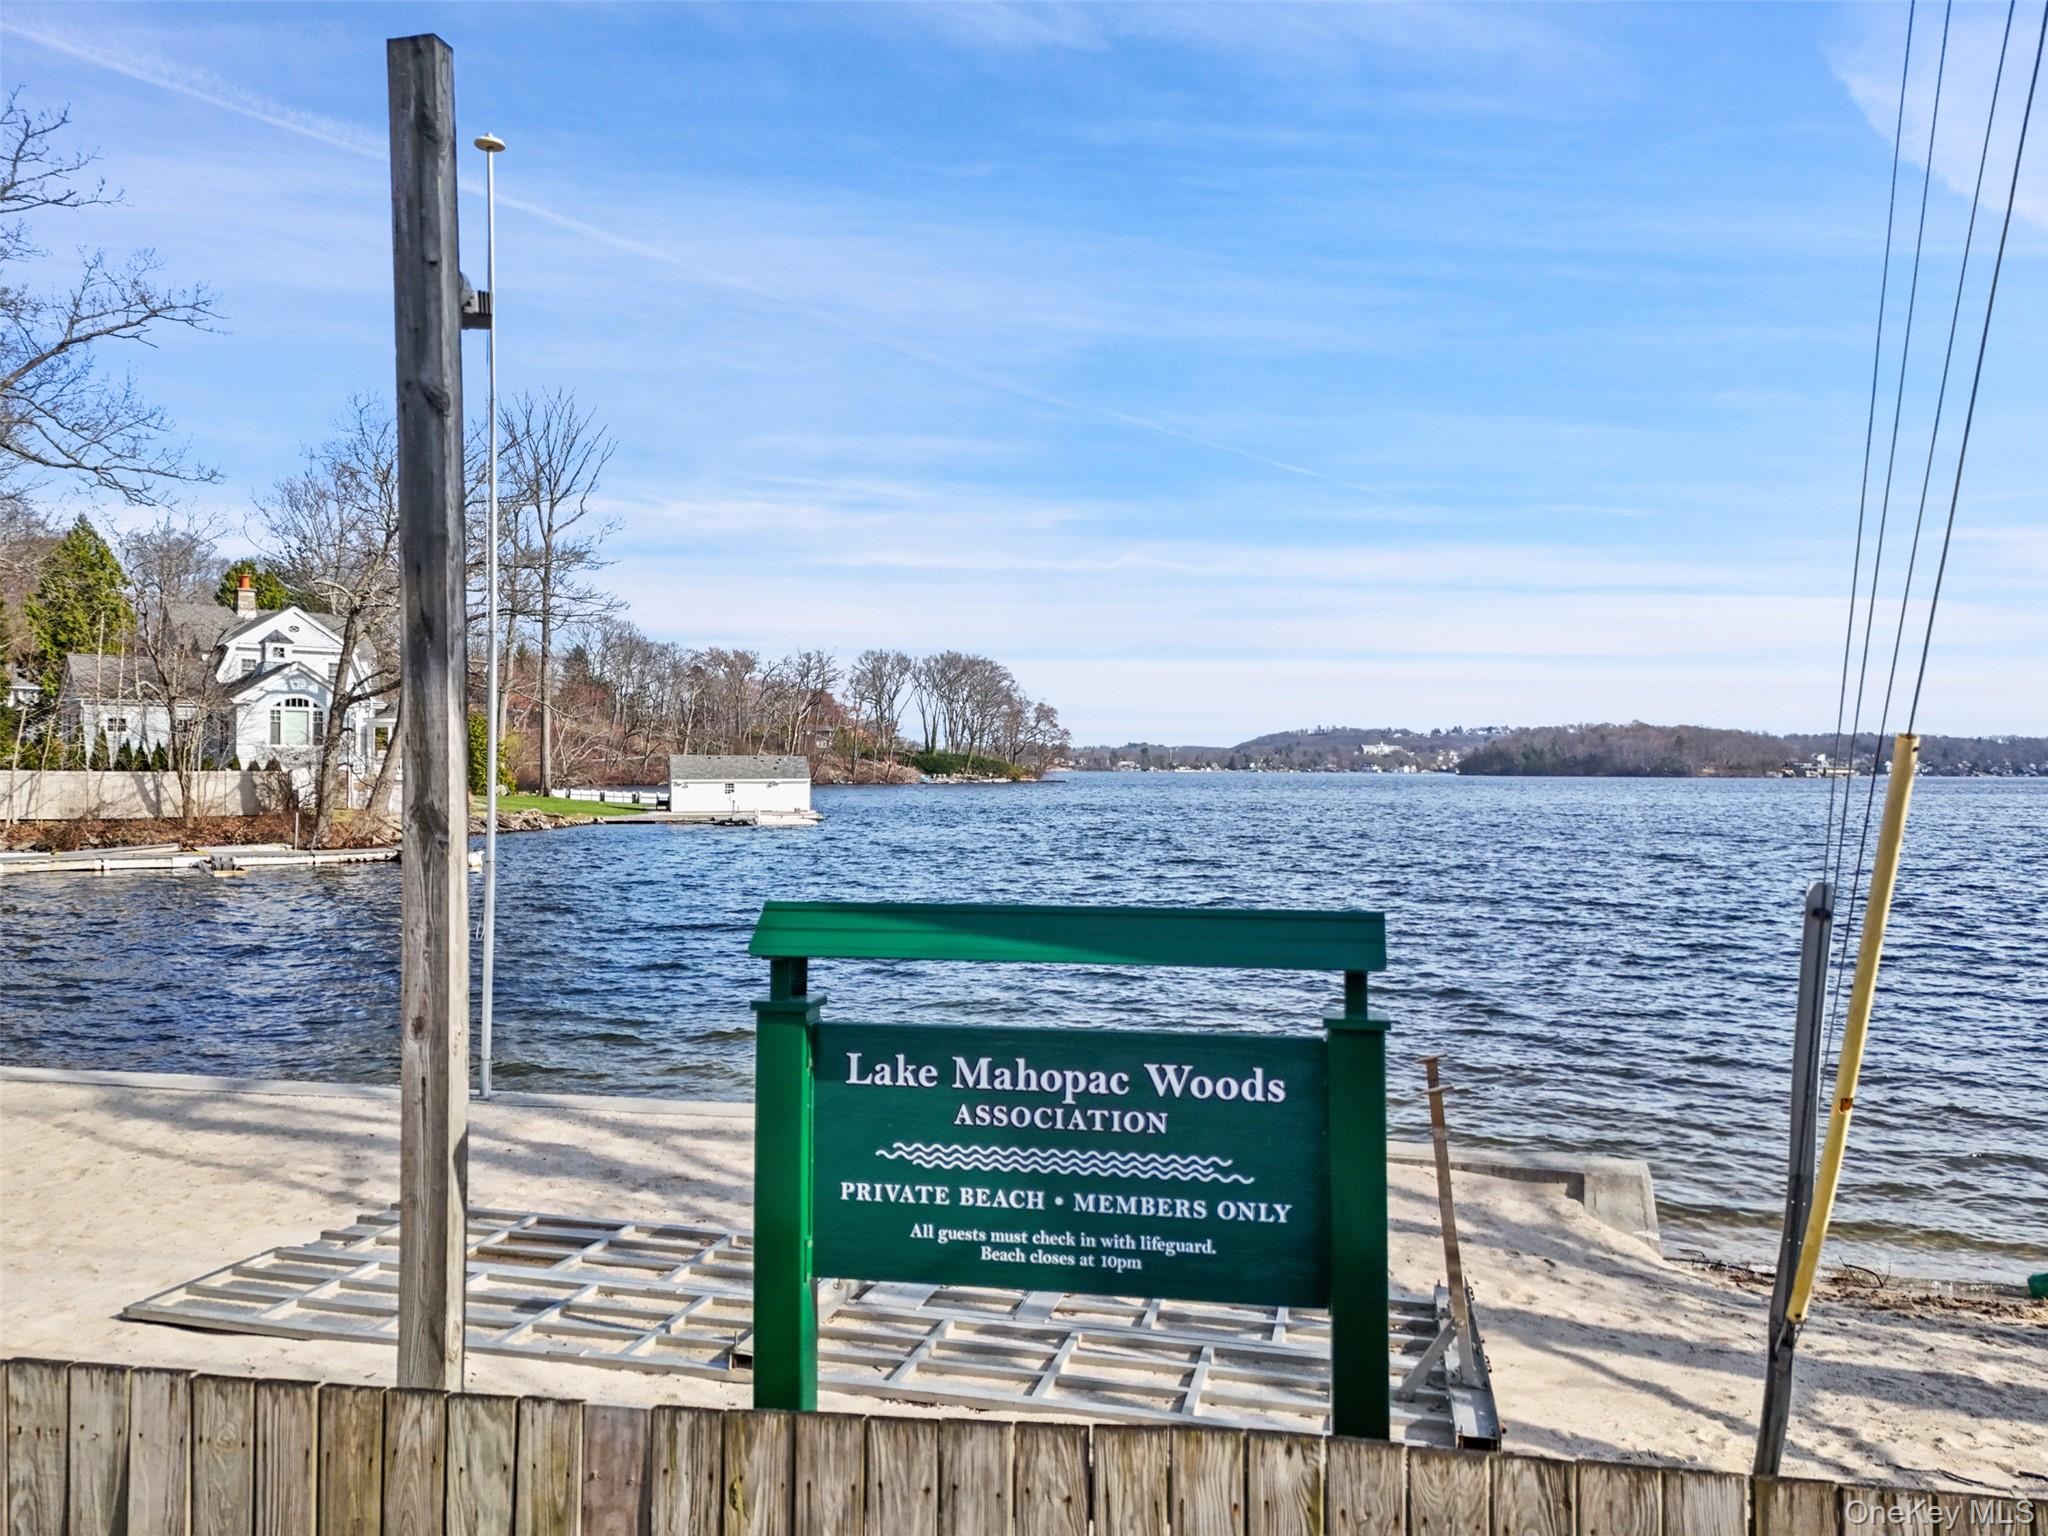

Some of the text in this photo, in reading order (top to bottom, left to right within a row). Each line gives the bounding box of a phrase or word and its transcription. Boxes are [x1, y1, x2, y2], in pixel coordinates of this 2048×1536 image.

[845, 1052, 1286, 1105] Lake Mahopac Woods
[953, 1103, 1169, 1134] ASSOCIATION
[840, 1181, 1292, 1223] PRIVATE BEACH MEMBERS ONLY
[909, 1223, 1217, 1257] All guests must check in with lifeguard.
[980, 1245, 1142, 1273] Beach closes at 10pm
